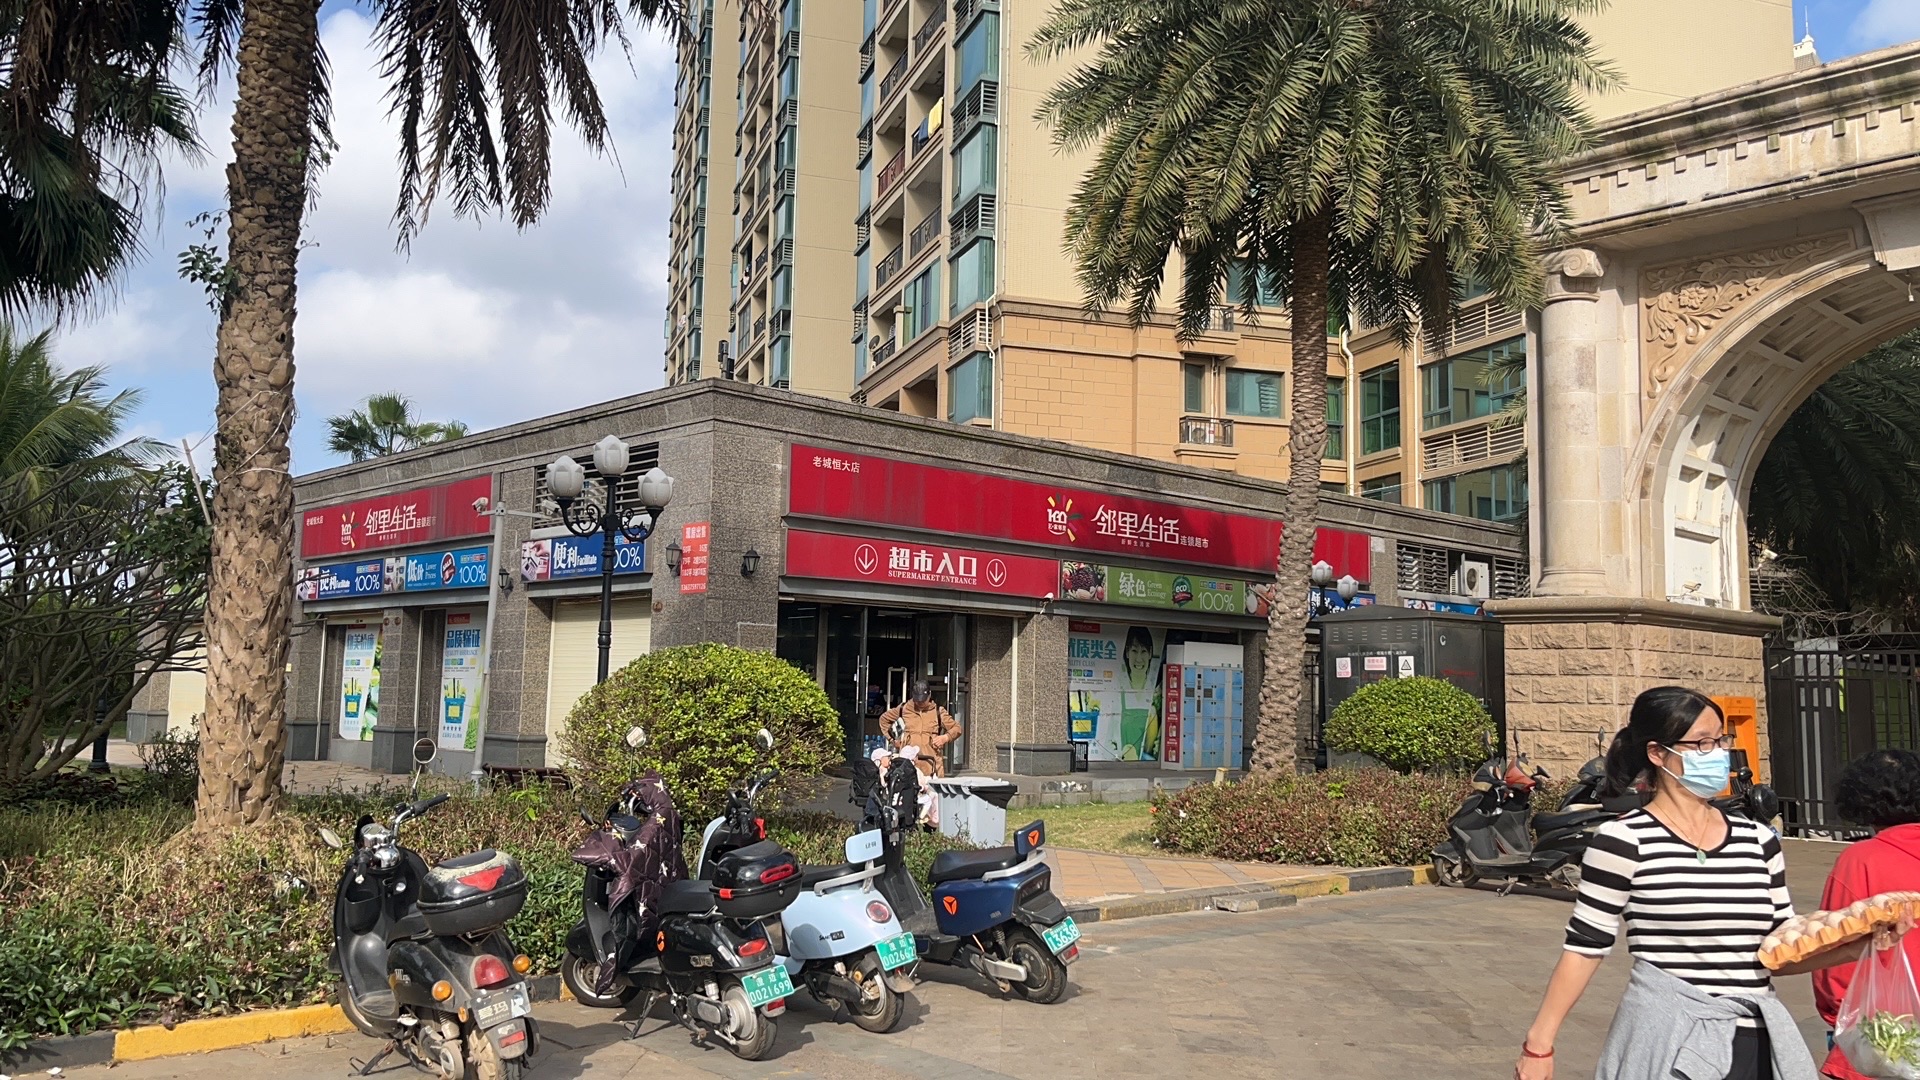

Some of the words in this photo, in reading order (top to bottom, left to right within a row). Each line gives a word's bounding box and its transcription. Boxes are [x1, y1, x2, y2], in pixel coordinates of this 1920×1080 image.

[812, 456, 861, 473] 老城恒大店
[363, 503, 417, 536] 邻里生活
[1090, 504, 1179, 544] 邻里生活
[1180, 535, 1209, 549] 连锁超市
[553, 541, 578, 569] 便利
[888, 546, 978, 578] 超市入口
[407, 559, 424, 583] 低价
[459, 563, 487, 584] 100%
[887, 569, 941, 582] SUPERMARKET
[941, 574, 978, 585] ENTRANCE
[354, 573, 380, 592] 100%
[1118, 571, 1146, 597] 绿色
[1147, 580, 1162, 590] Green
[1175, 585, 1188, 593] eco
[1197, 591, 1235, 612] 100%
[446, 629, 481, 648] 品质保证
[1440, 635, 1446, 646] C
[1048, 923, 1079, 951] 13638
[749, 980, 791, 1003] 0021699
